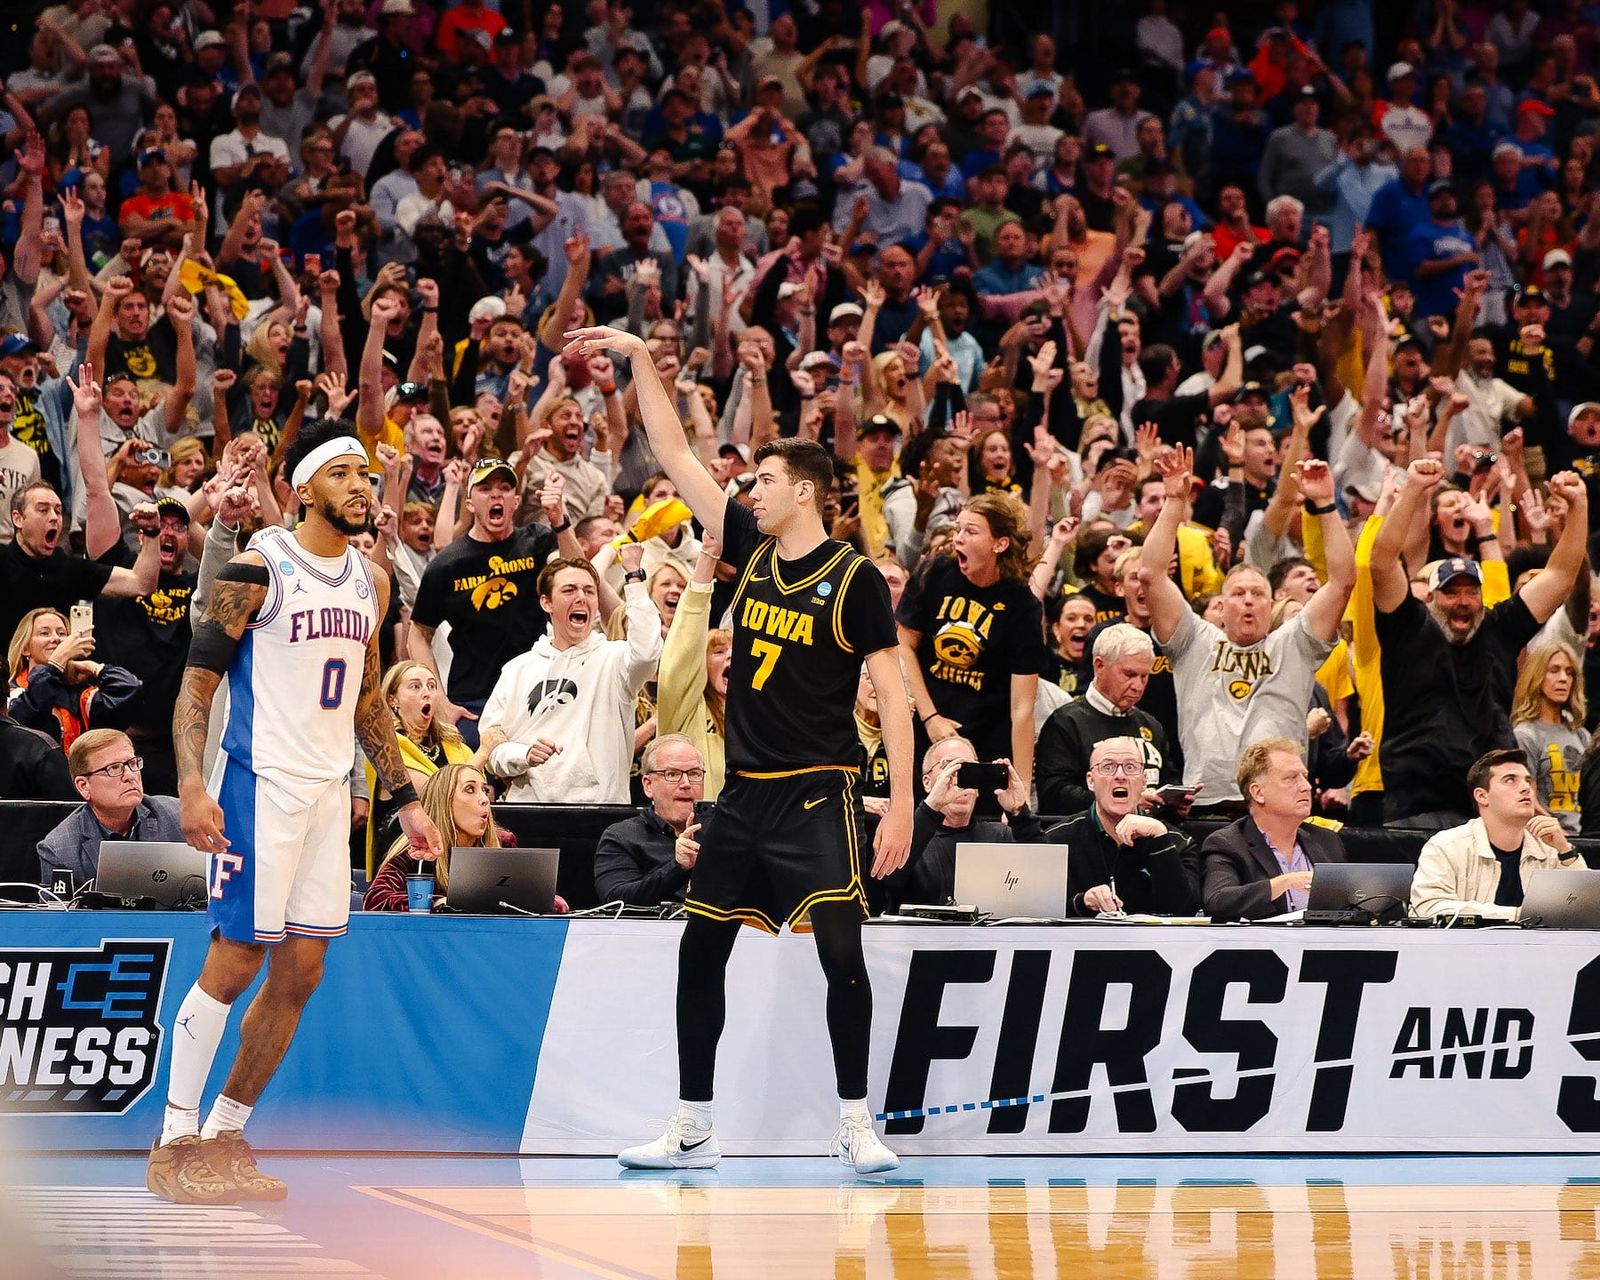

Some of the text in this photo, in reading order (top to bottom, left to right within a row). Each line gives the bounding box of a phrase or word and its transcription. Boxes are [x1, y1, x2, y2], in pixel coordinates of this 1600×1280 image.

[290, 607, 370, 647] FLORIDA
[741, 597, 814, 646] IOWA
[936, 596, 994, 640] IOWA
[319, 657, 347, 710] 0
[750, 638, 783, 691] 7
[152, 869, 168, 883] hp
[210, 853, 245, 899] F
[884, 949, 1399, 1135] FIRST
[1388, 1006, 1535, 1080] AND
